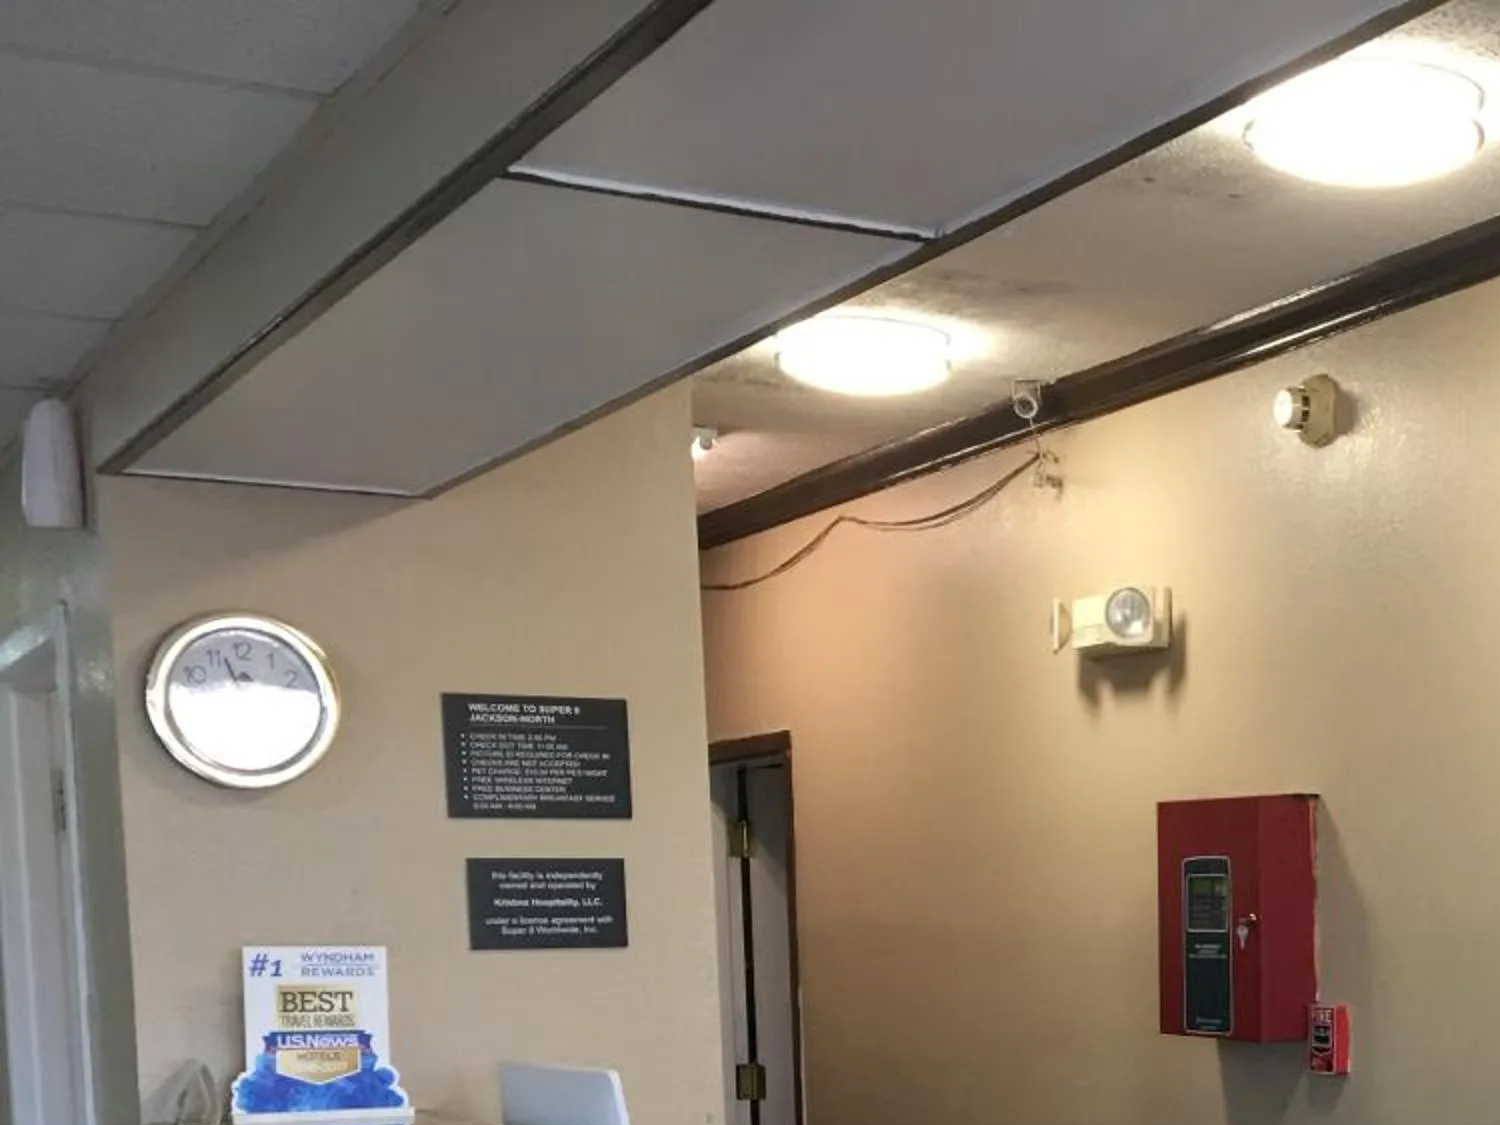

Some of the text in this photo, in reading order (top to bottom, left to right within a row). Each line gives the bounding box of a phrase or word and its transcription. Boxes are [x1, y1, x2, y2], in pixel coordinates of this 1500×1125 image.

[206, 649, 223, 668] 11
[234, 642, 253, 661] 12
[267, 652, 275, 669] 1
[285, 669, 299, 689] 2
[467, 703, 520, 713] WELCOME
[523, 704, 537, 713] TO
[539, 705, 573, 715] SUPER
[469, 713, 556, 725] JACKSON-NORTH
[249, 952, 283, 978] #1
[301, 952, 375, 963] WYNDHAM
[301, 966, 376, 977] REWARDS
[279, 991, 353, 1013] BEST
